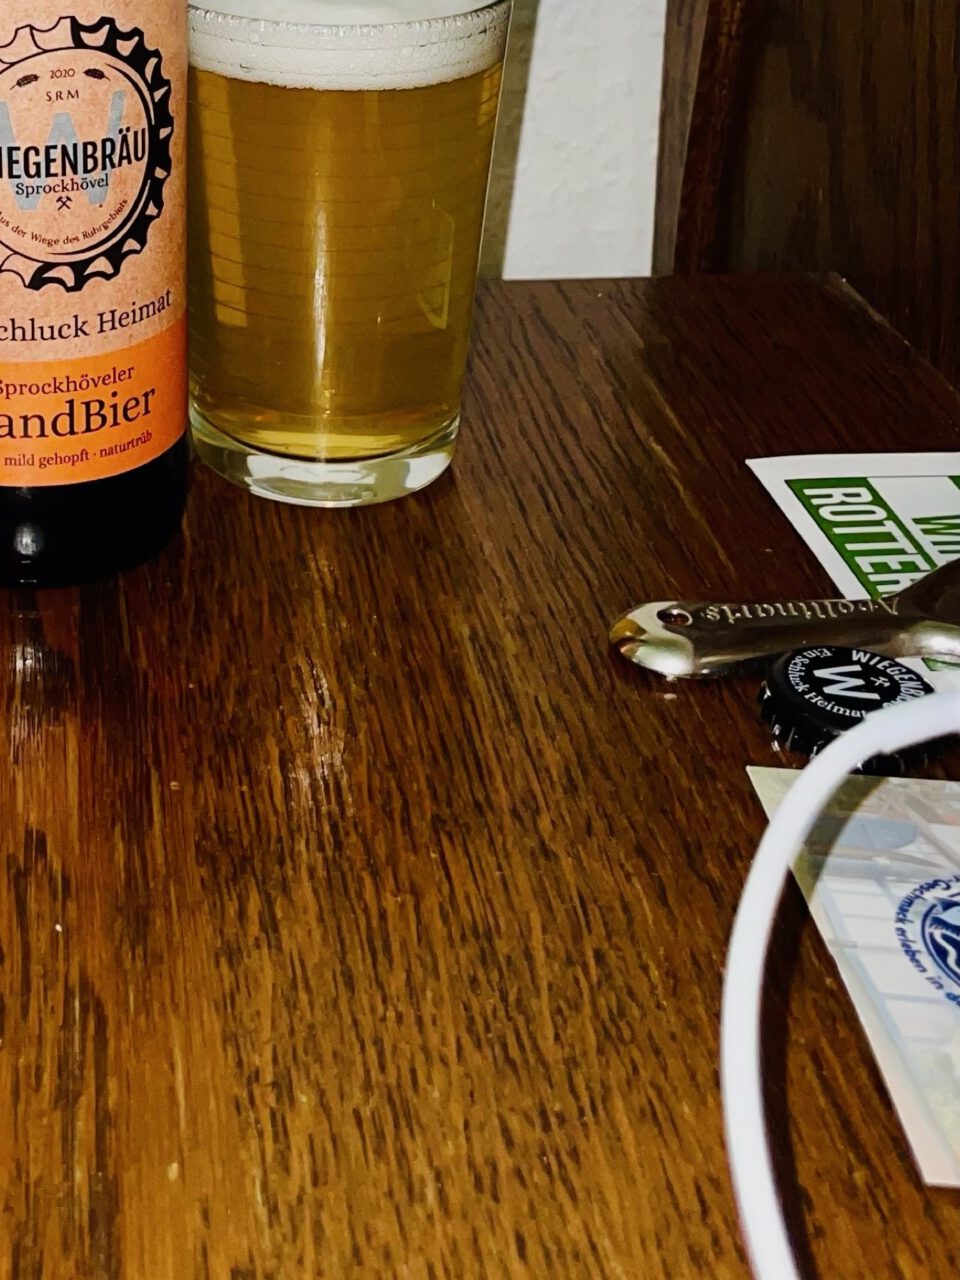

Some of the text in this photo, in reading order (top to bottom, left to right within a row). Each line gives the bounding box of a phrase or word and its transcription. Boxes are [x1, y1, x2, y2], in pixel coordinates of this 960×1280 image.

[49, 67, 76, 80] 2020
[15, 173, 109, 198] Sprockhövel
[11, 223, 27, 238] der
[30, 231, 60, 247] Wiege
[62, 234, 80, 245] des
[97, 288, 172, 334] Heimat
[4, 451, 35, 467] mild
[38, 450, 90, 469] gehopft
[99, 430, 152, 458] naturtrüb
[803, 648, 833, 658] Ein
